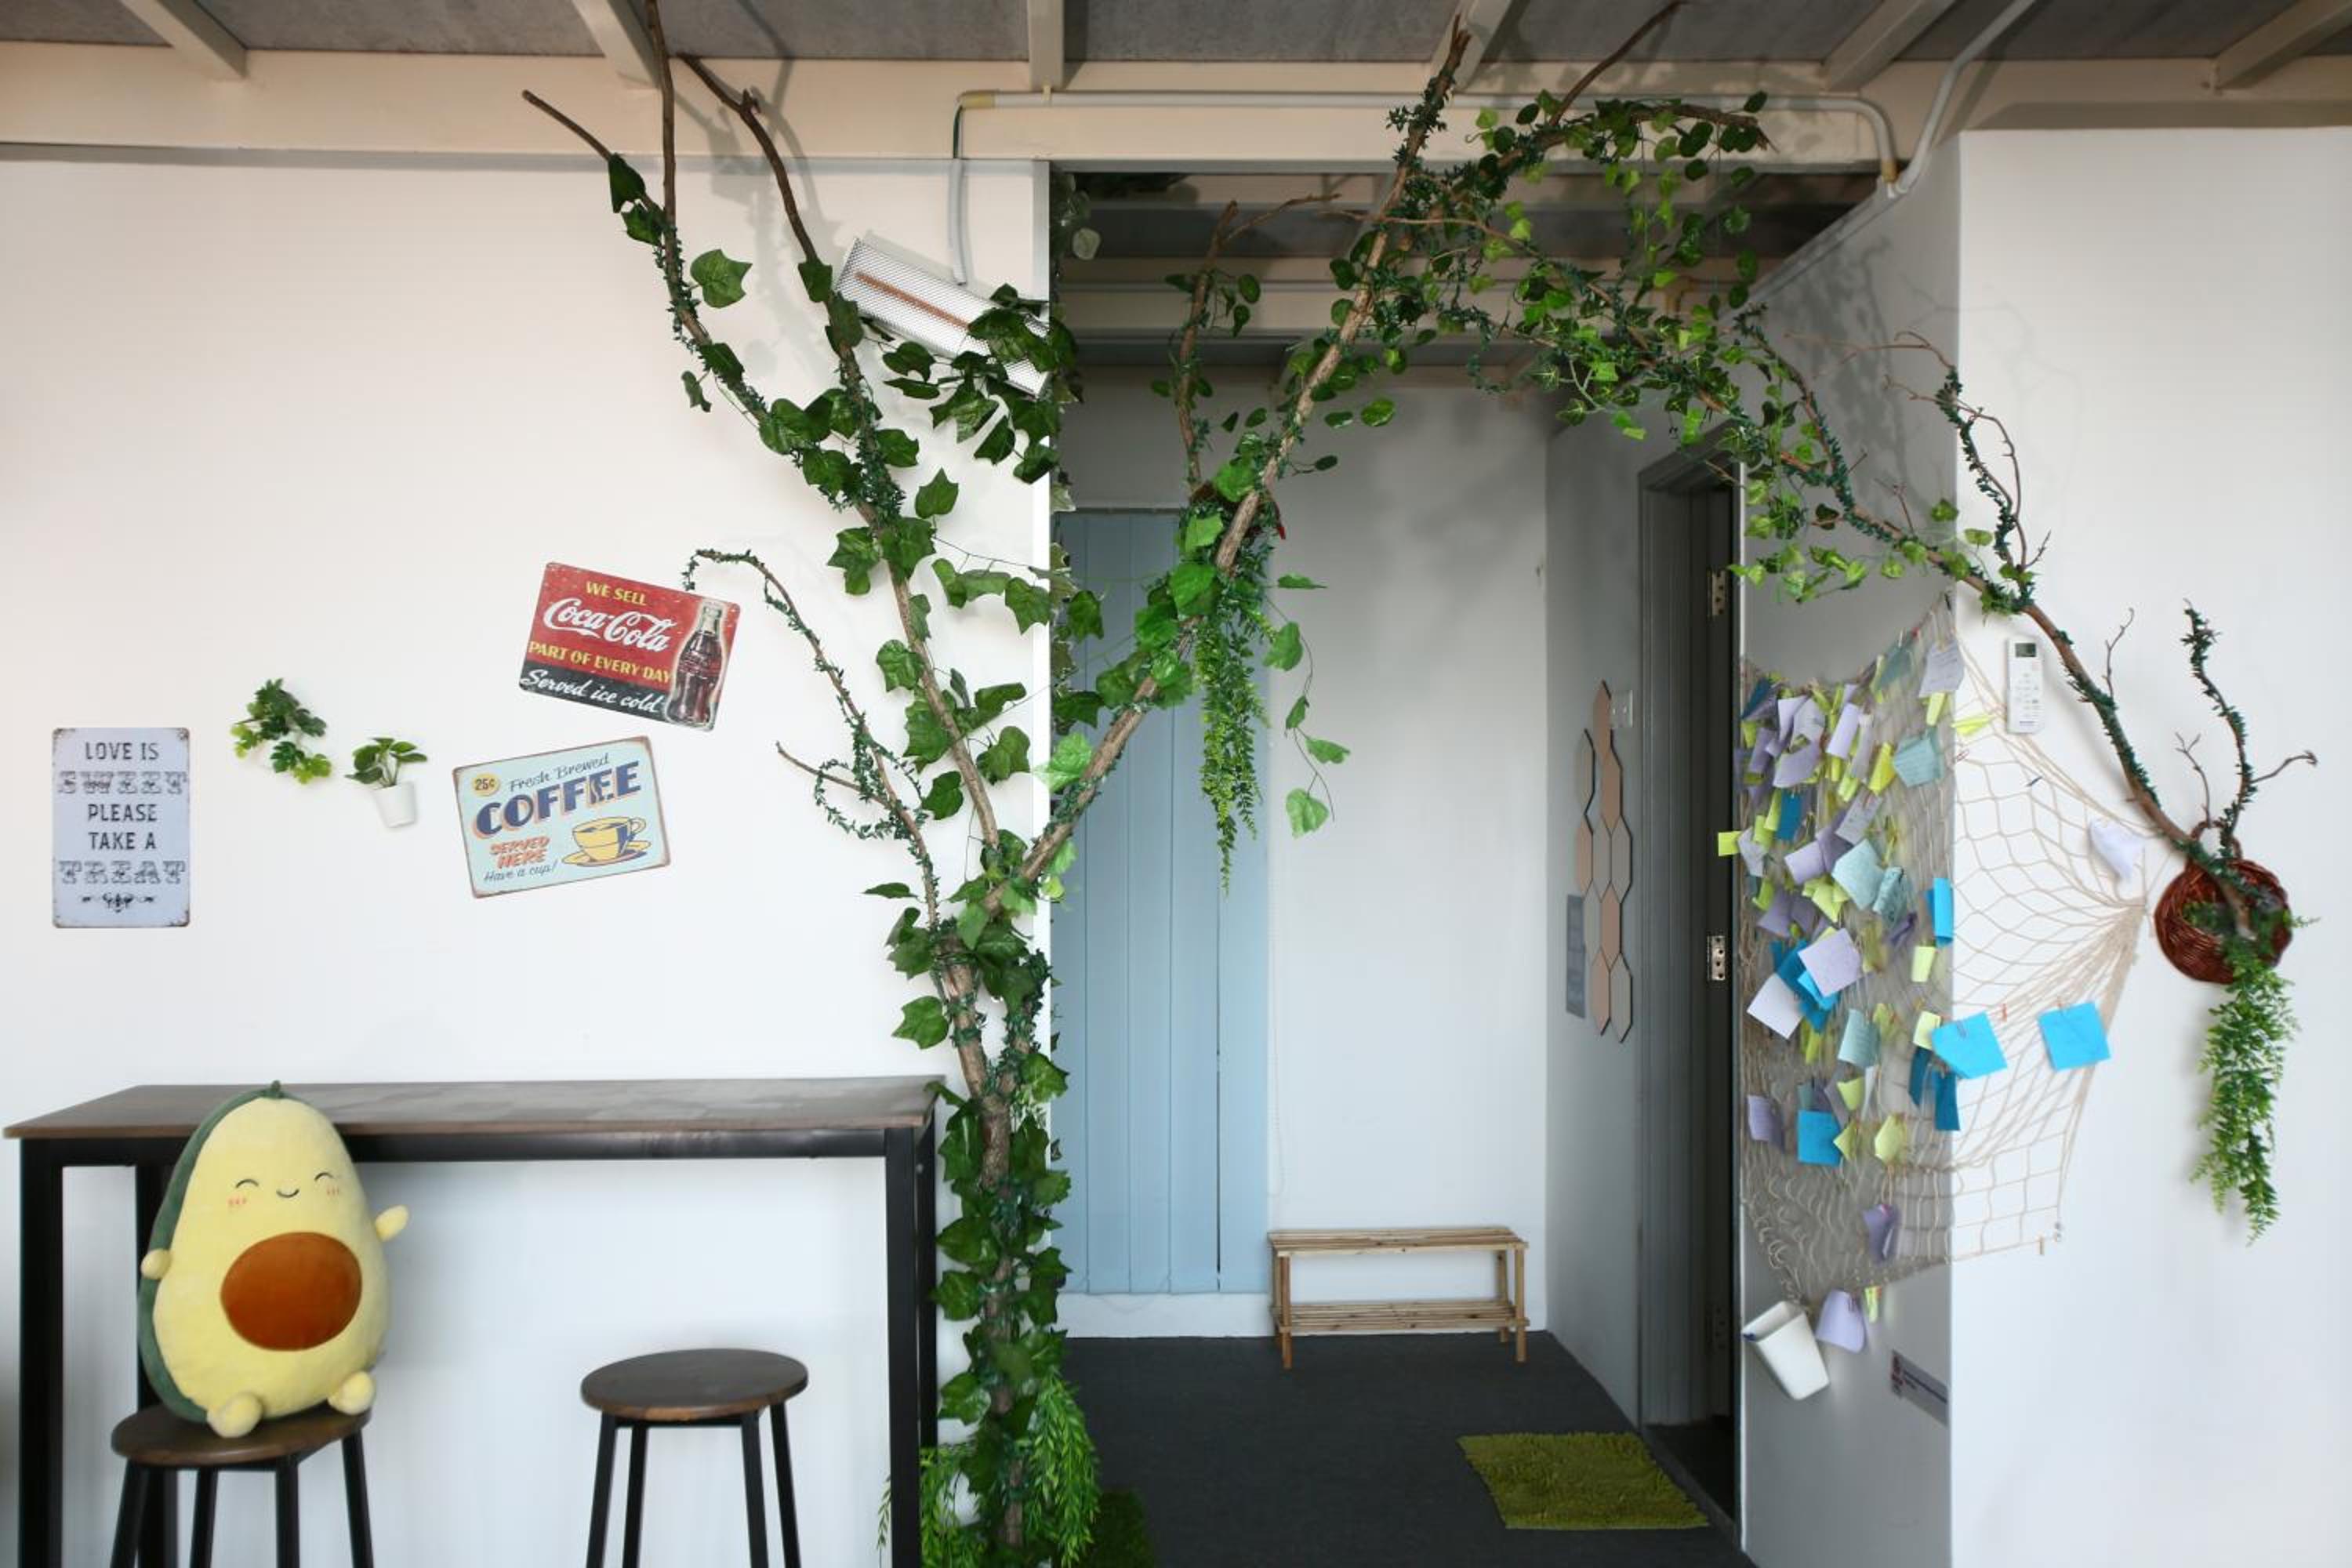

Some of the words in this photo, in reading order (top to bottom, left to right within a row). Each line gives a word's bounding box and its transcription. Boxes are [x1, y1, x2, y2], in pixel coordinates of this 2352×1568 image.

[586, 581, 610, 597] WE
[614, 589, 647, 606] SELL
[543, 598, 677, 652] Coca-Cola
[528, 641, 568, 661] PART
[570, 650, 592, 665] OF
[594, 655, 640, 676] EVERY
[642, 669, 672, 684] DAY
[521, 669, 590, 697] Served
[591, 687, 617, 704] ice
[620, 695, 658, 713] cold
[85, 742, 132, 760] LOVE
[141, 742, 159, 760] IS
[58, 771, 187, 794] SWEET
[509, 769, 550, 792] Fresh
[554, 753, 609, 780] Brewed
[475, 760, 642, 836] COFFEE
[87, 804, 158, 822] PLEASE
[88, 832, 136, 850] TAKE
[144, 832, 157, 850] A
[496, 849, 547, 869] HERE
[59, 861, 186, 884] TREAT
[483, 868, 515, 882] Have
[517, 867, 526, 877] a
